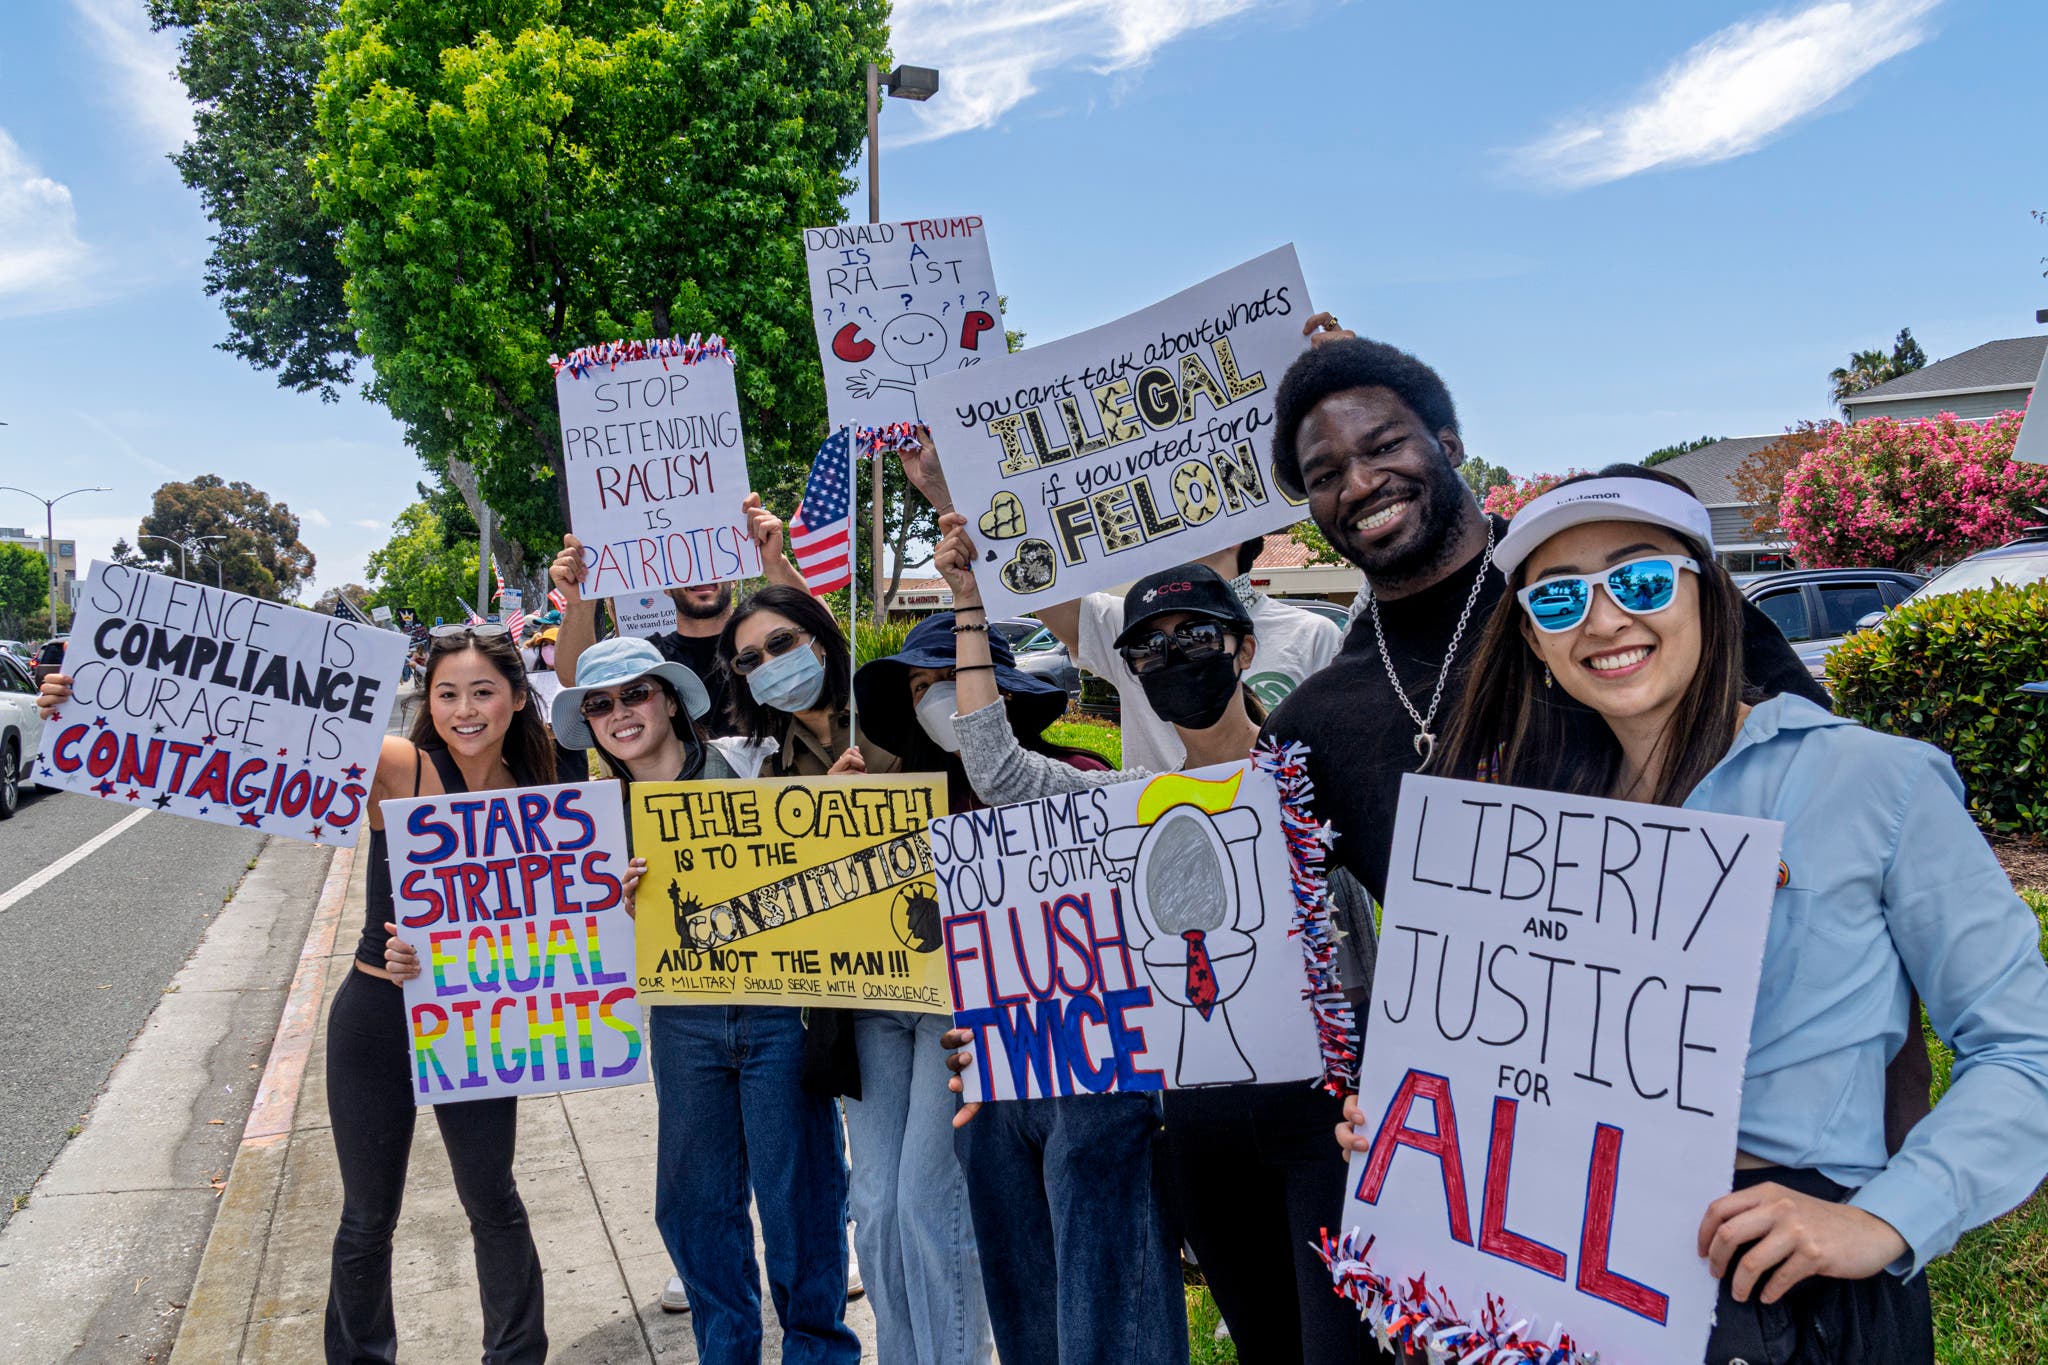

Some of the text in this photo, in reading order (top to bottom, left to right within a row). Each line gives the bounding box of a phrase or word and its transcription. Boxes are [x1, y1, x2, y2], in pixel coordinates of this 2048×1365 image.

[806, 216, 983, 251] DONALD TRUMP
[840, 244, 930, 266] IS A
[595, 374, 689, 413] STOP
[956, 286, 1292, 428] you can't talk about whats
[566, 411, 738, 461] PRETENDING
[986, 335, 1266, 480] ILLEGAL
[596, 451, 715, 509] RACISM
[1042, 407, 1274, 506] if you voted for a
[643, 508, 672, 530] IS
[1048, 438, 1270, 568] FELON
[580, 526, 761, 596] PATRIOTISM
[1158, 582, 1192, 594] CCS
[91, 563, 357, 669] SILENCE IS
[633, 612, 659, 620] choose
[660, 610, 676, 618] LOV
[640, 620, 660, 628] stand
[94, 618, 381, 723] COMPLIANCE
[71, 661, 343, 759] COURAGE IS
[53, 723, 367, 827] CONTAGIOUS
[406, 789, 596, 864] STARS
[644, 784, 933, 842] THE OATH
[931, 788, 1110, 864] SOMETIMES
[400, 851, 622, 928] STRIPES
[674, 842, 797, 873] IS TO THE
[934, 846, 1107, 916] YOU GOTTA
[1412, 795, 1751, 952] LIBERTY
[430, 916, 627, 997] EQUAL
[656, 949, 701, 974] AND
[710, 950, 758, 974] NOT
[772, 950, 821, 975] THE
[942, 888, 1138, 1010] FLUSH
[1523, 917, 1568, 942] AND
[639, 976, 664, 988] OUR
[672, 976, 736, 990] MILITARY
[744, 978, 783, 991] SHOULD
[788, 979, 821, 993] SERVE
[826, 981, 856, 994] WITH
[1384, 924, 1722, 1117] JUSTICE
[411, 987, 642, 1093] RIGHTS
[954, 986, 1168, 1102] TWICE
[1498, 1064, 1552, 1107] FOR
[1354, 1067, 1670, 1327] ALL
